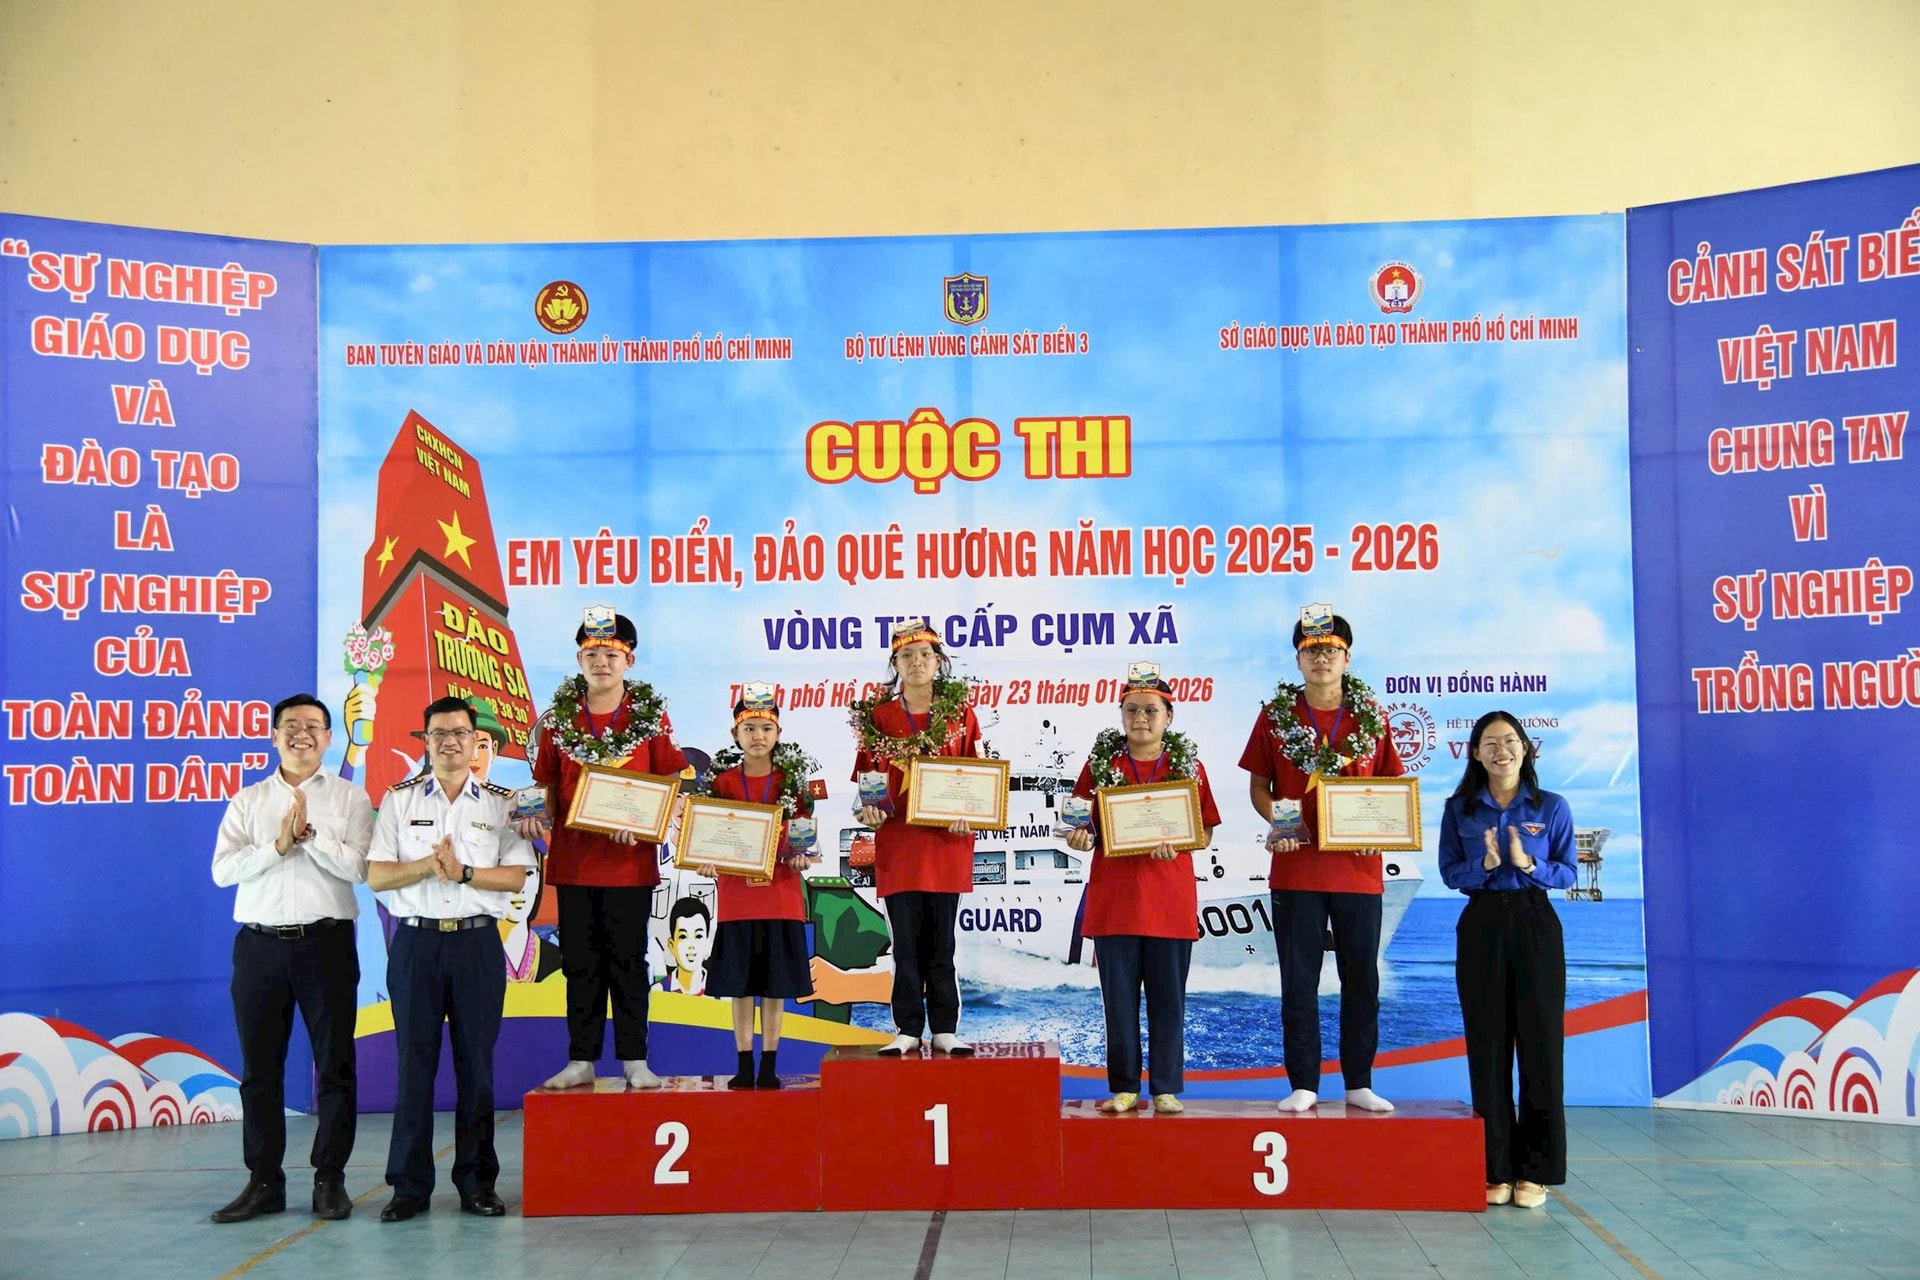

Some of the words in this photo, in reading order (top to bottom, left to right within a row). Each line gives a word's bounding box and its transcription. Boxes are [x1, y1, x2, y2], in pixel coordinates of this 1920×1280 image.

[1668, 242, 1766, 305] CẢNH
[1777, 230, 1849, 291] SÁT
[1858, 207, 1920, 282] BIỂ
[108, 263, 277, 316] NGHIỆP
[32, 313, 145, 362] GIÁO
[158, 326, 250, 375] DỤC
[347, 344, 375, 365] BAN
[380, 341, 423, 365] TUYÊN
[428, 340, 460, 365] GIÁO
[465, 340, 482, 364] VÀ
[487, 340, 515, 364] DÂN
[520, 339, 547, 368] VẬN
[552, 338, 597, 362] THÀNH
[601, 335, 619, 362] ỦY
[623, 337, 668, 361] THÀNH
[673, 333, 701, 361] PHỐ
[705, 333, 723, 360] HỒ
[727, 336, 751, 360] CHÍ
[755, 338, 791, 360] MINH
[845, 333, 864, 362] BỘ
[868, 336, 887, 358] TƯ
[889, 333, 924, 362] LỆNH
[929, 332, 965, 356] VÙNG
[970, 328, 1008, 356] CẢNH
[1013, 330, 1038, 355] SÁT
[1043, 325, 1076, 354] BIỂN
[1080, 333, 1089, 353] 3
[1220, 321, 1239, 349] SỞ
[1244, 323, 1276, 348] GIÁO
[1281, 326, 1309, 352] DỤC
[1314, 322, 1331, 346] VÀ
[1336, 320, 1364, 346] ĐÀO
[1369, 324, 1395, 350] TẠO
[1400, 319, 1447, 344] THÀNH
[1452, 313, 1481, 342] PHỐ
[1486, 313, 1505, 341] HỒ
[1510, 315, 1534, 341] CHÍ
[1539, 318, 1577, 339] MINH
[1718, 324, 1797, 390] VIỆT
[1806, 319, 1896, 376] NAM
[112, 381, 175, 427] VÀ
[42, 439, 140, 486] ĐÀO
[153, 450, 239, 498] TẠO
[416, 424, 463, 472] CHXHCN
[806, 407, 1001, 495] CUỘC
[1014, 415, 1131, 479] THI
[1709, 419, 1834, 474] CHUNG
[1843, 411, 1909, 463] TAY
[416, 446, 440, 476] VIỆT
[443, 466, 470, 499] NAM
[115, 505, 174, 551] LÀ
[1789, 484, 1827, 542] VÌ
[508, 539, 562, 586] EM
[573, 529, 639, 585] YÊU
[651, 517, 743, 590] BIỂN,
[754, 519, 825, 583] ĐẢO
[837, 523, 904, 587] QUÊ
[917, 527, 1036, 579] HƯƠNG
[1049, 519, 1131, 577] NĂM
[1143, 527, 1215, 586] HỌC
[1227, 525, 1314, 574] 2025
[1351, 523, 1439, 572] 2026
[22, 569, 94, 620] SỰ
[101, 570, 271, 623] NGHIỆP
[1713, 569, 1766, 631] SỰ
[1771, 557, 1912, 625] NGHIỆP
[95, 626, 191, 676] CỦA
[443, 601, 509, 655] ĐẢO
[763, 609, 862, 650] VÒNG
[945, 603, 1018, 647] CẤP
[1032, 613, 1114, 653] CỤM
[1129, 604, 1178, 645] XÃ
[434, 629, 502, 690] TRƯỜNG
[503, 662, 531, 701] SA
[1386, 676, 1420, 694] ĐƠN
[1426, 677, 1441, 697] VỊ
[1447, 670, 1494, 693] ĐỒNG
[1500, 671, 1547, 692] HÀNH
[1692, 651, 1814, 714] TRỒNG
[1823, 647, 1920, 710] NGƯỜ
[3, 693, 132, 740] TOÀN
[145, 689, 271, 739] ĐẢNG
[790, 679, 830, 711] phố
[831, 679, 857, 707] Hồ
[968, 679, 1002, 708] gày
[1007, 680, 1031, 704] 23
[1037, 678, 1089, 706] tháng
[1096, 679, 1117, 703] 01
[1168, 677, 1213, 703] 2026
[1409, 703, 1436, 751] AMERICA
[1446, 717, 1461, 731] HỆ
[4, 757, 133, 805] TOÀN
[1020, 825, 1050, 838] NAM
[959, 909, 1042, 932] GUARD
[654, 1121, 689, 1185] 2
[924, 1103, 949, 1165] 1
[1253, 1131, 1288, 1195] 3
